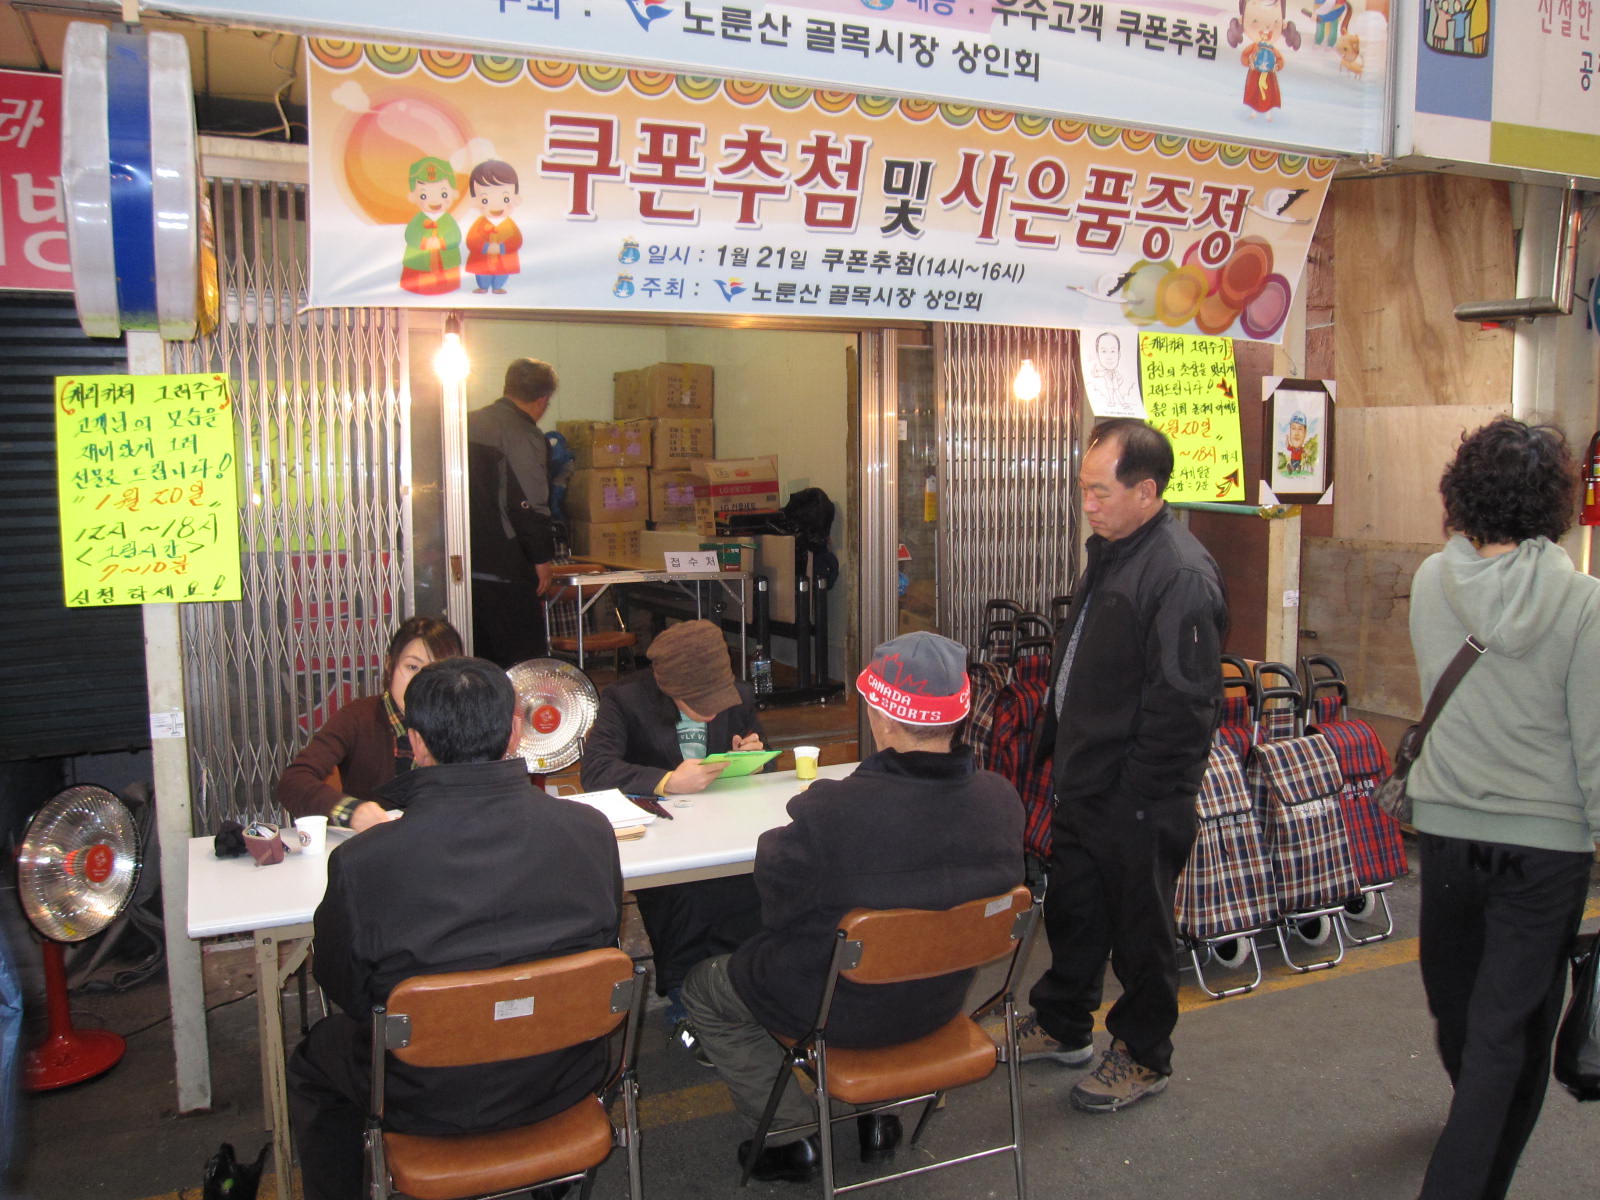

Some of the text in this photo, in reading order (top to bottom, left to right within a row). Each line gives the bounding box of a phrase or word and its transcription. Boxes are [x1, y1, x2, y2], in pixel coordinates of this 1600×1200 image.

[683, 1, 1040, 82] 노룬산 골목시장 상인회
[1117, 9, 1219, 60] 쿠폰추첨
[541, 114, 1246, 263] 쿠폰추첨 및 사은품증정
[647, 244, 691, 266] 일시
[717, 244, 750, 267] 1월
[756, 246, 808, 270] 21일
[640, 277, 685, 299] 주최
[752, 282, 821, 304] 노룬산
[828, 284, 917, 308] 골목시장
[923, 289, 983, 311] 상인회
[868, 674, 911, 706] CANADA
[880, 697, 942, 721] SPORTS
